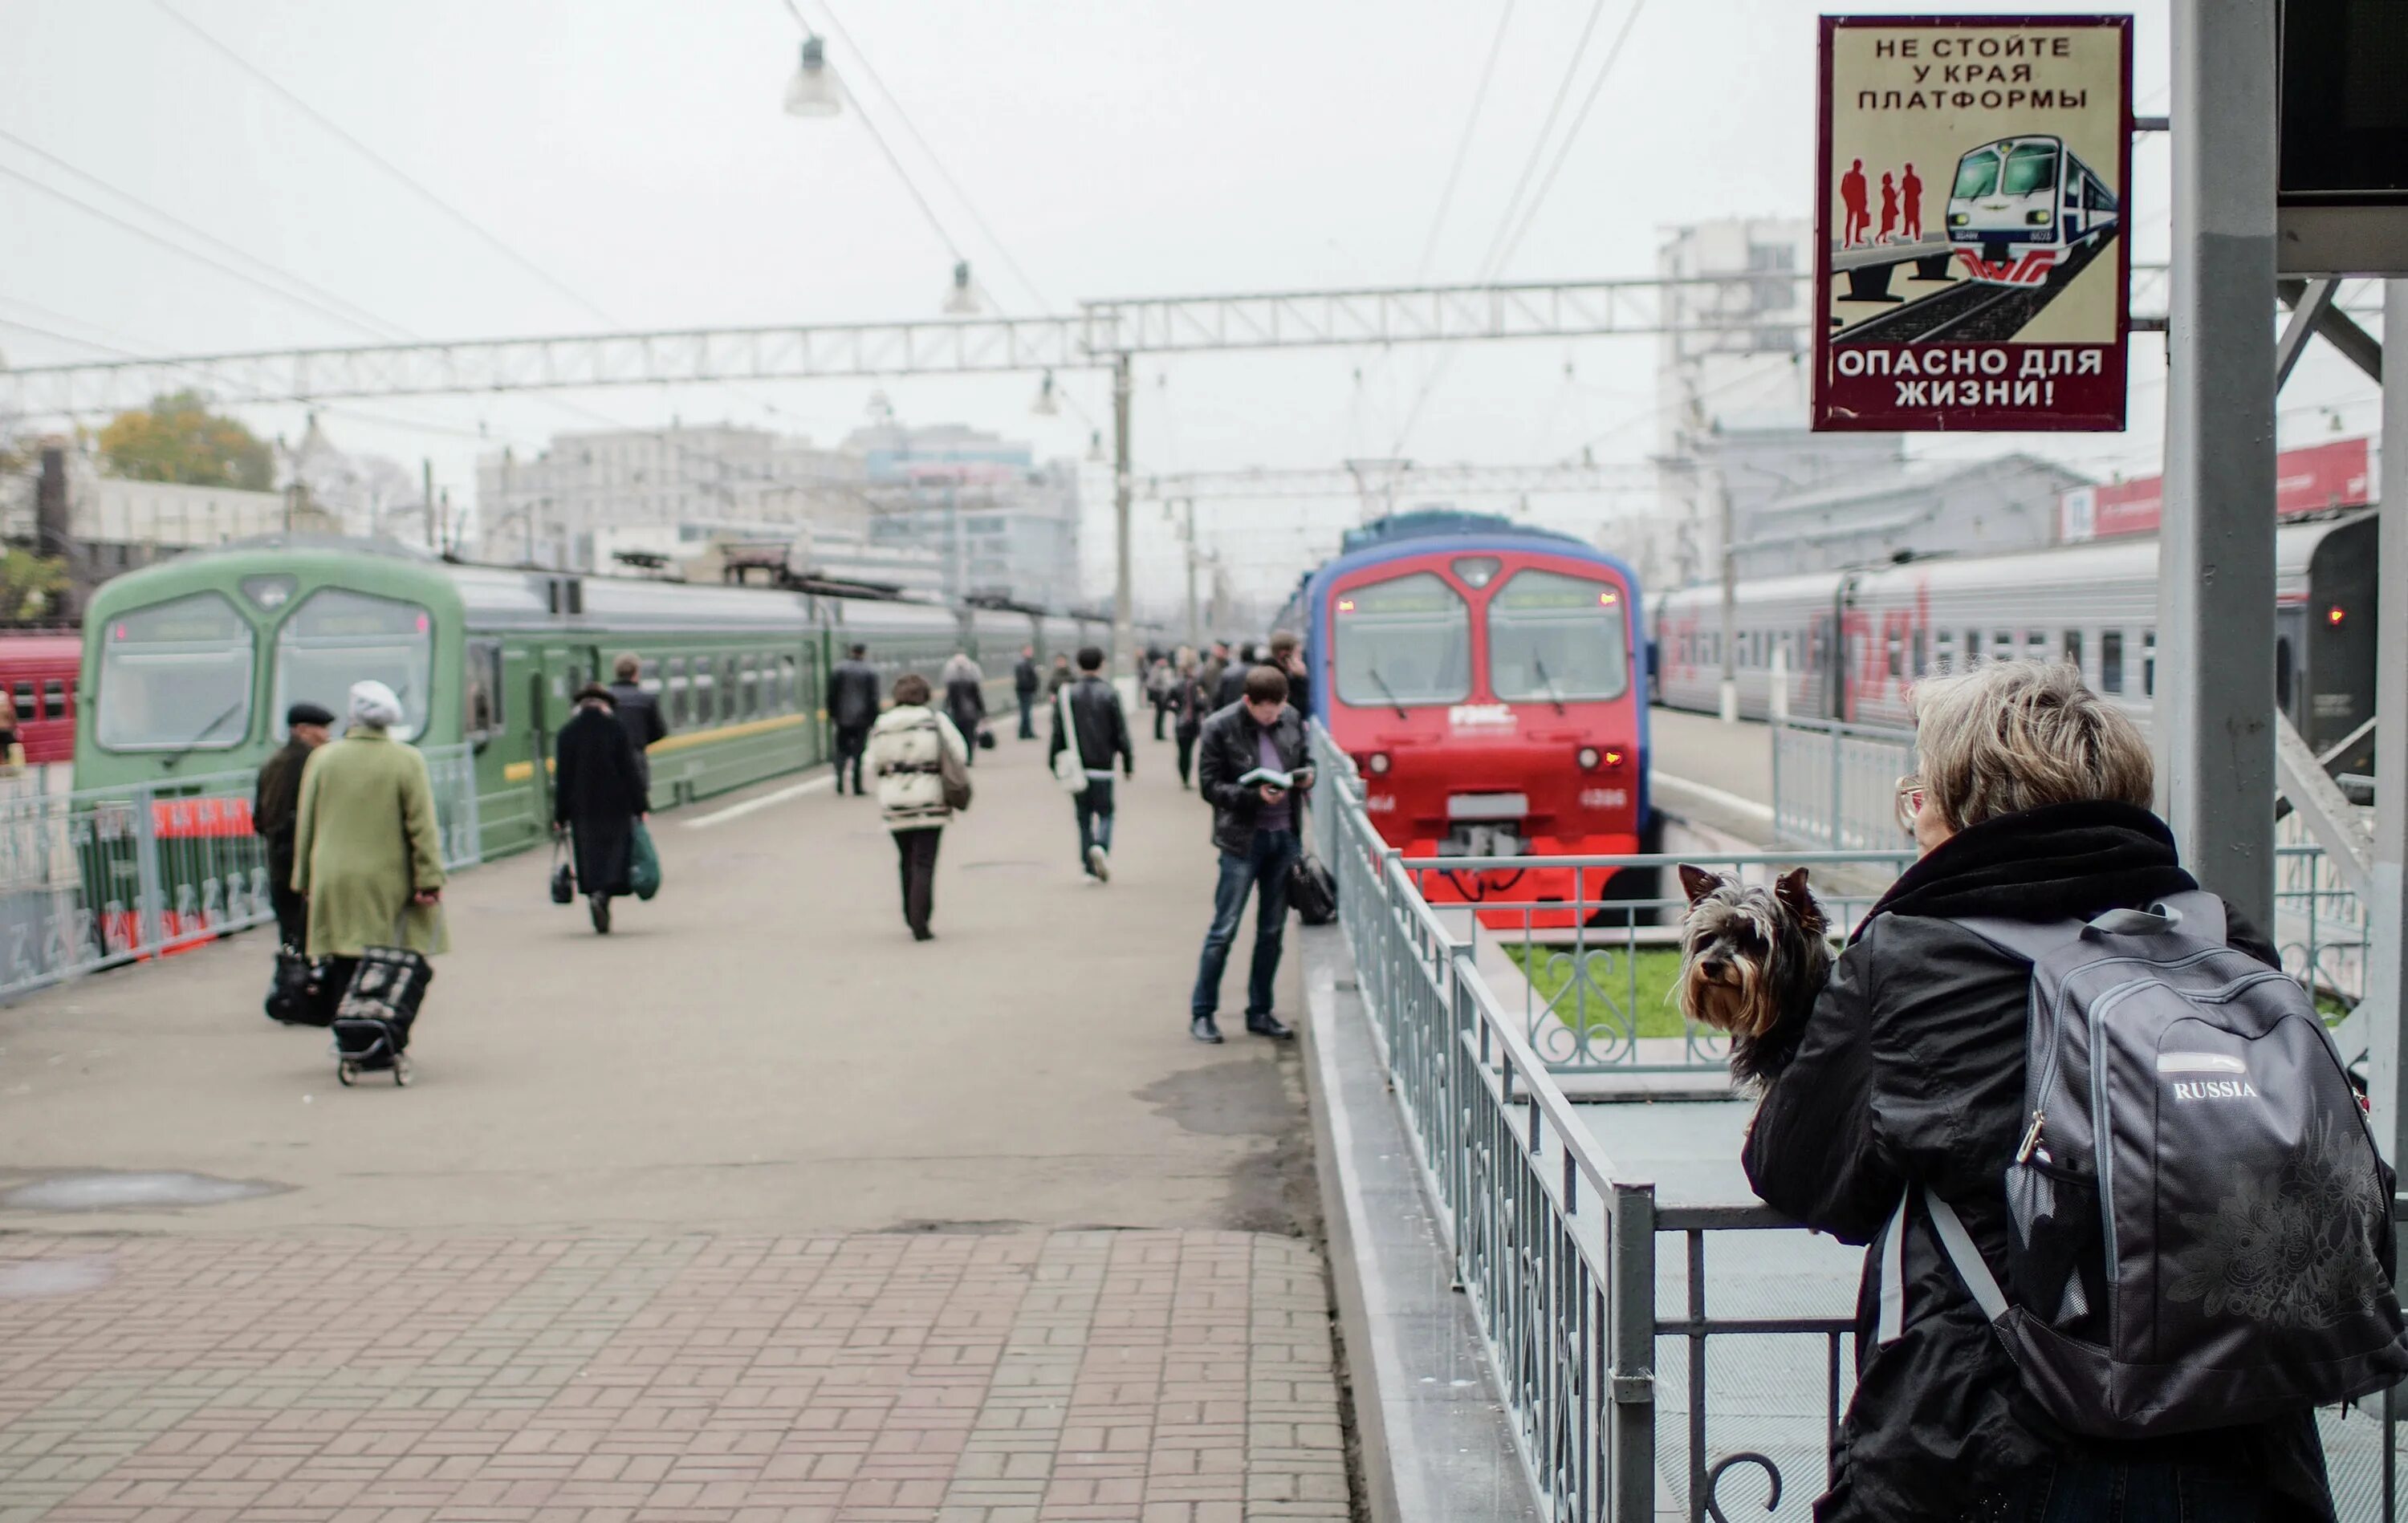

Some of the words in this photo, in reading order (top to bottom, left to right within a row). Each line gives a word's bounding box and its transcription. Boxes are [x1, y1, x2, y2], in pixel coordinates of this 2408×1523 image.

[1876, 39, 1918, 58] НЕ
[1932, 35, 2071, 59] СТОЙТЕ
[1913, 65, 1930, 83] У
[1944, 63, 2032, 83] КРАЯ
[1858, 89, 2087, 110] ПЛАТФОРМЫ
[1837, 349, 2008, 377] ОПАСНО
[2019, 348, 2103, 380] ДЛЯ
[1894, 380, 2055, 407] ЖИЗНИ!
[2173, 1080, 2258, 1099] RUSSIA
